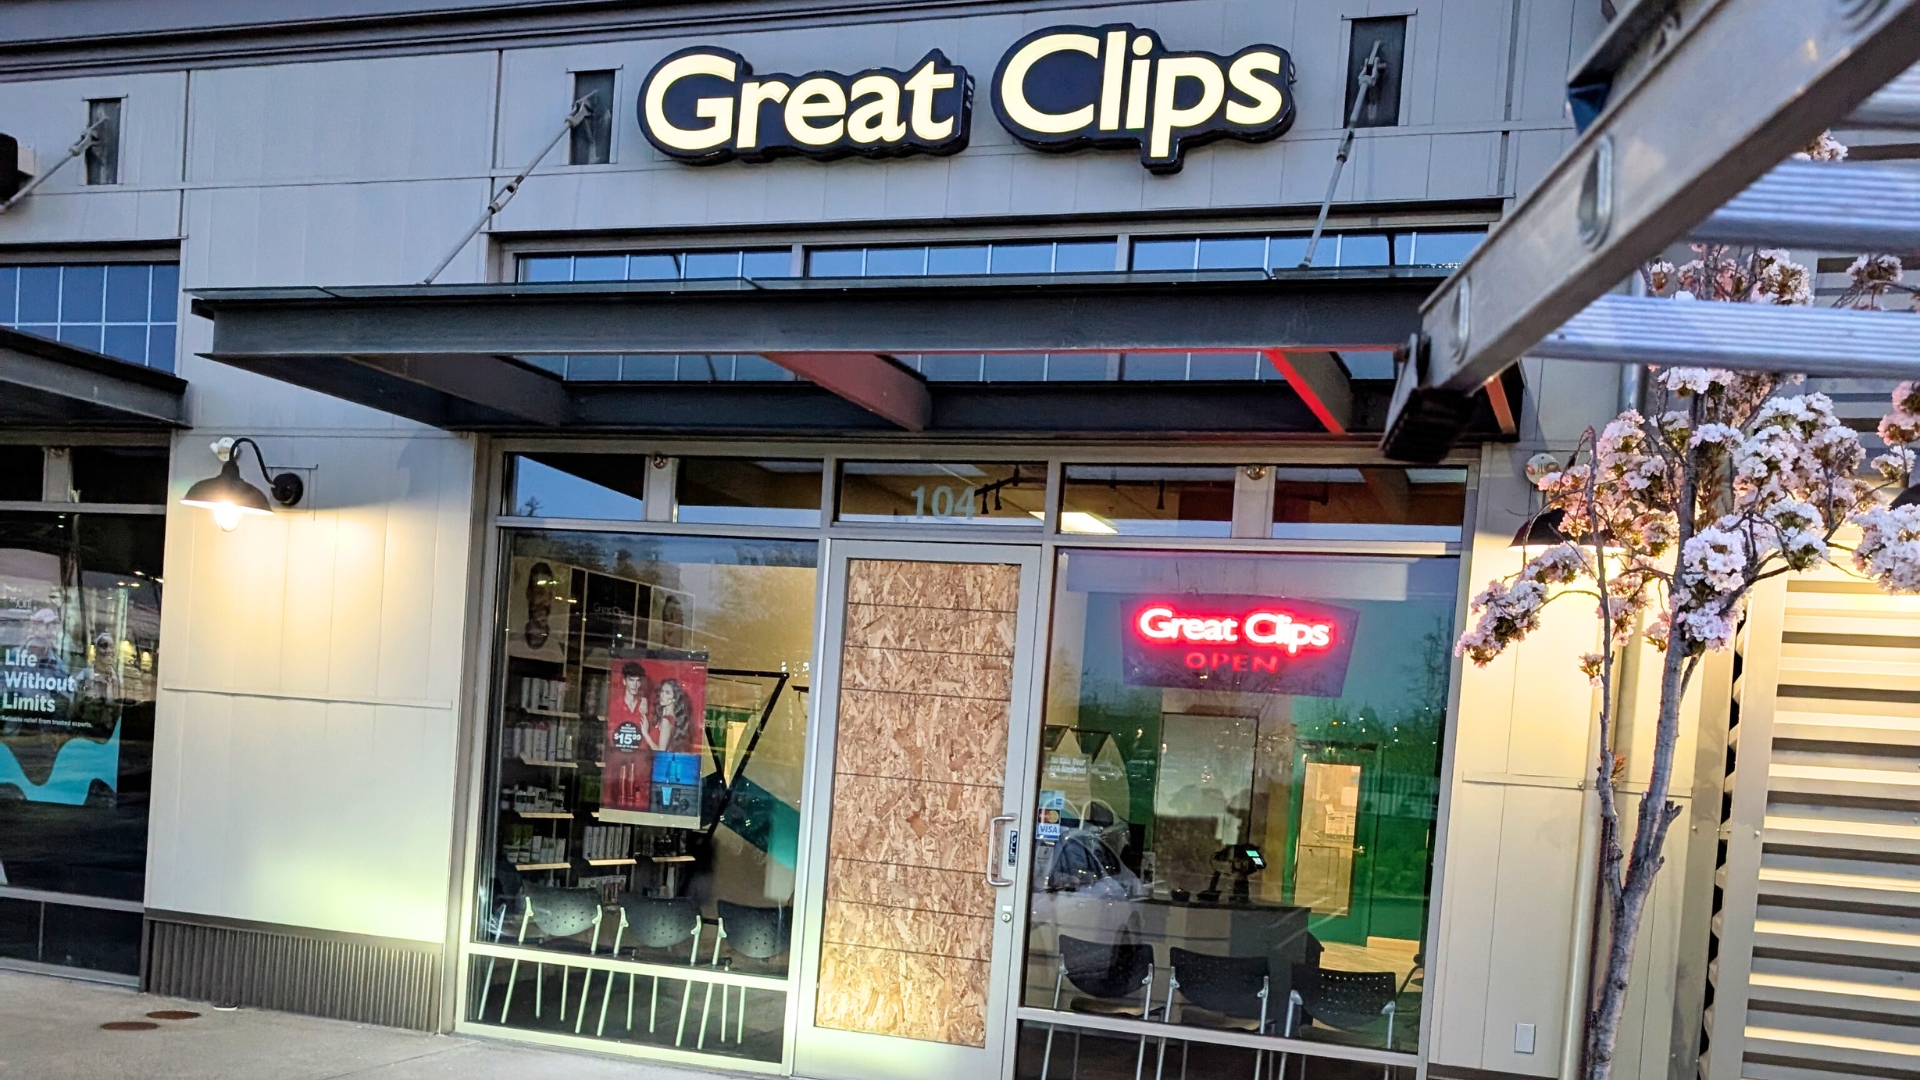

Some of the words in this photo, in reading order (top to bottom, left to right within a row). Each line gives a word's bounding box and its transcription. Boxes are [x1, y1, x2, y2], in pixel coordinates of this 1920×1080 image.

[645, 54, 954, 149] Great
[1001, 31, 1286, 158] Clips
[911, 485, 975, 520] 104
[1140, 608, 1238, 642] Great
[1245, 613, 1330, 654] Clips
[5, 648, 38, 667] Life
[1184, 652, 1279, 674] OPEN
[4, 671, 75, 692] Without
[2, 692, 56, 712] Limits
[1040, 825, 1058, 834] VISA
